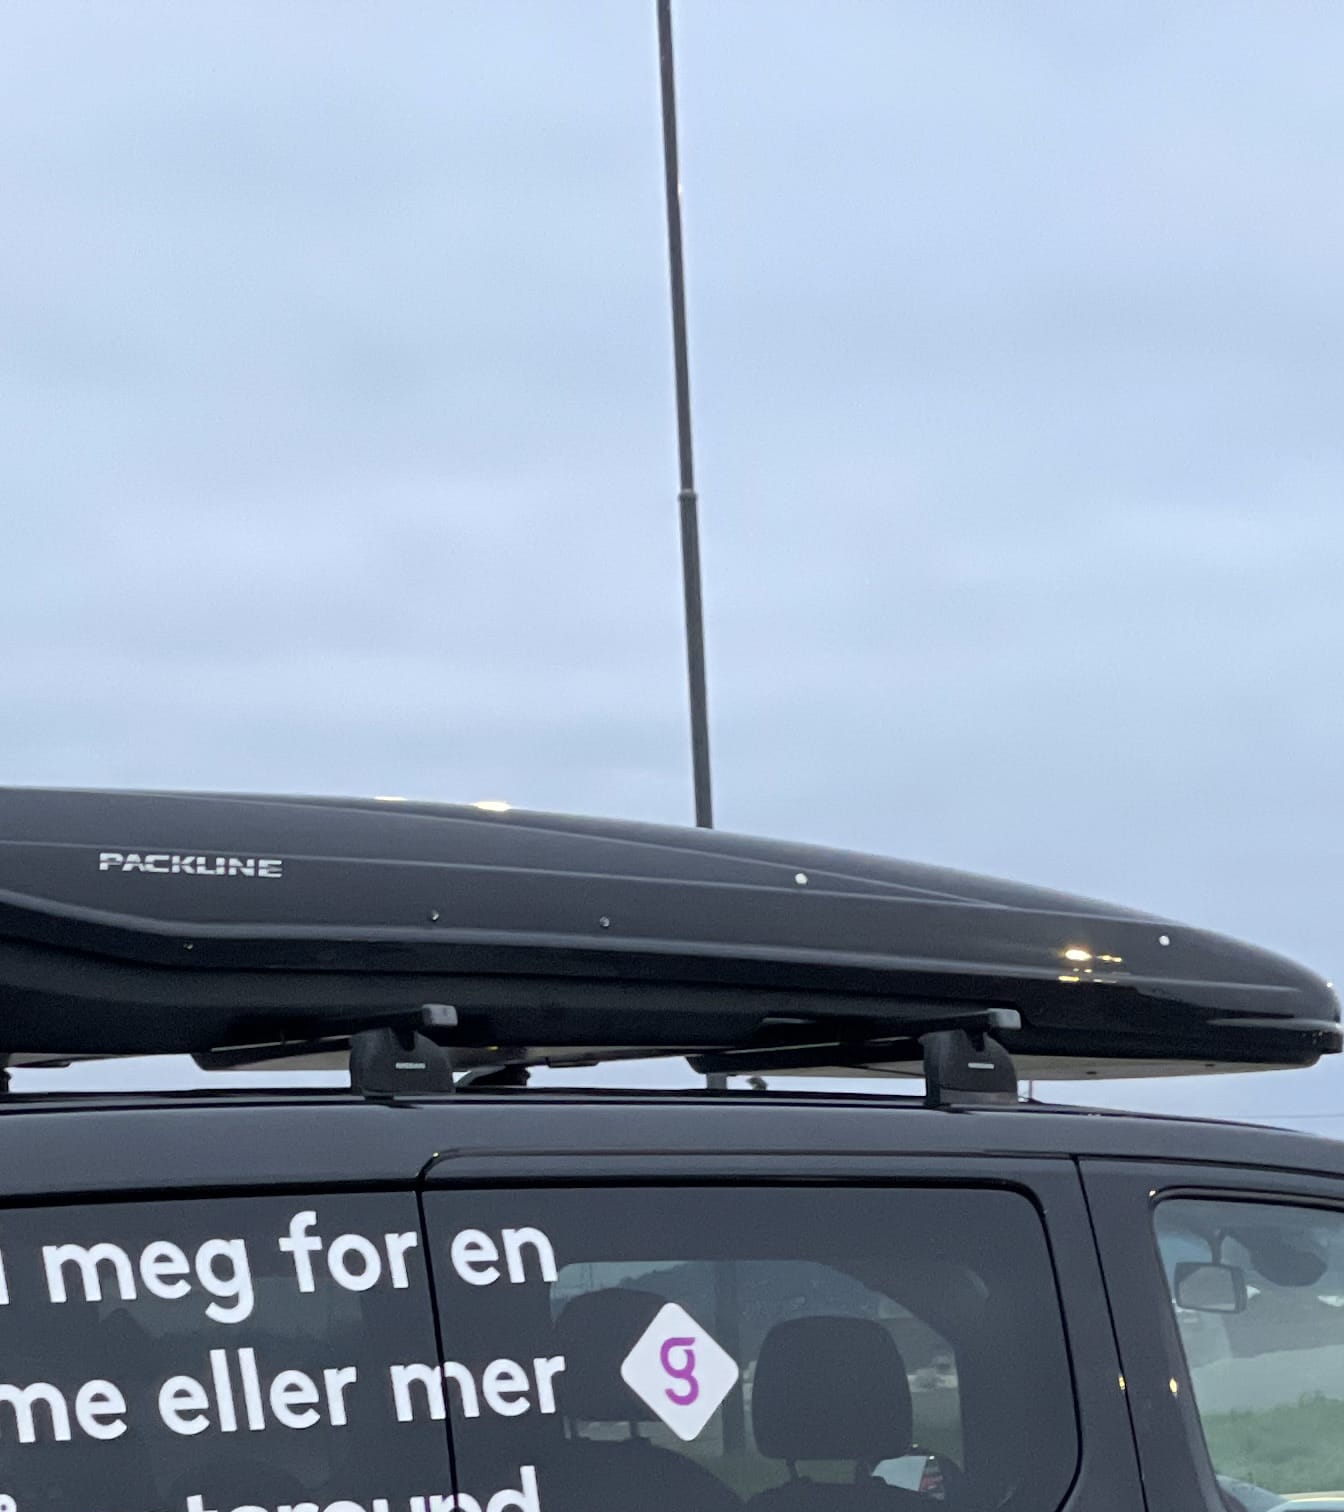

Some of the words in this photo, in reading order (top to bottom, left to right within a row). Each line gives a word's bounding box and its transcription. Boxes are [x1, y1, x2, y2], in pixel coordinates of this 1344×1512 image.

[99, 852, 283, 878] PACKLINE
[42, 1238, 255, 1324] meg
[278, 1210, 418, 1293] for
[451, 1227, 559, 1286] en
[158, 1347, 357, 1435] eller
[390, 1355, 566, 1422] mer
[659, 1336, 699, 1406] g
